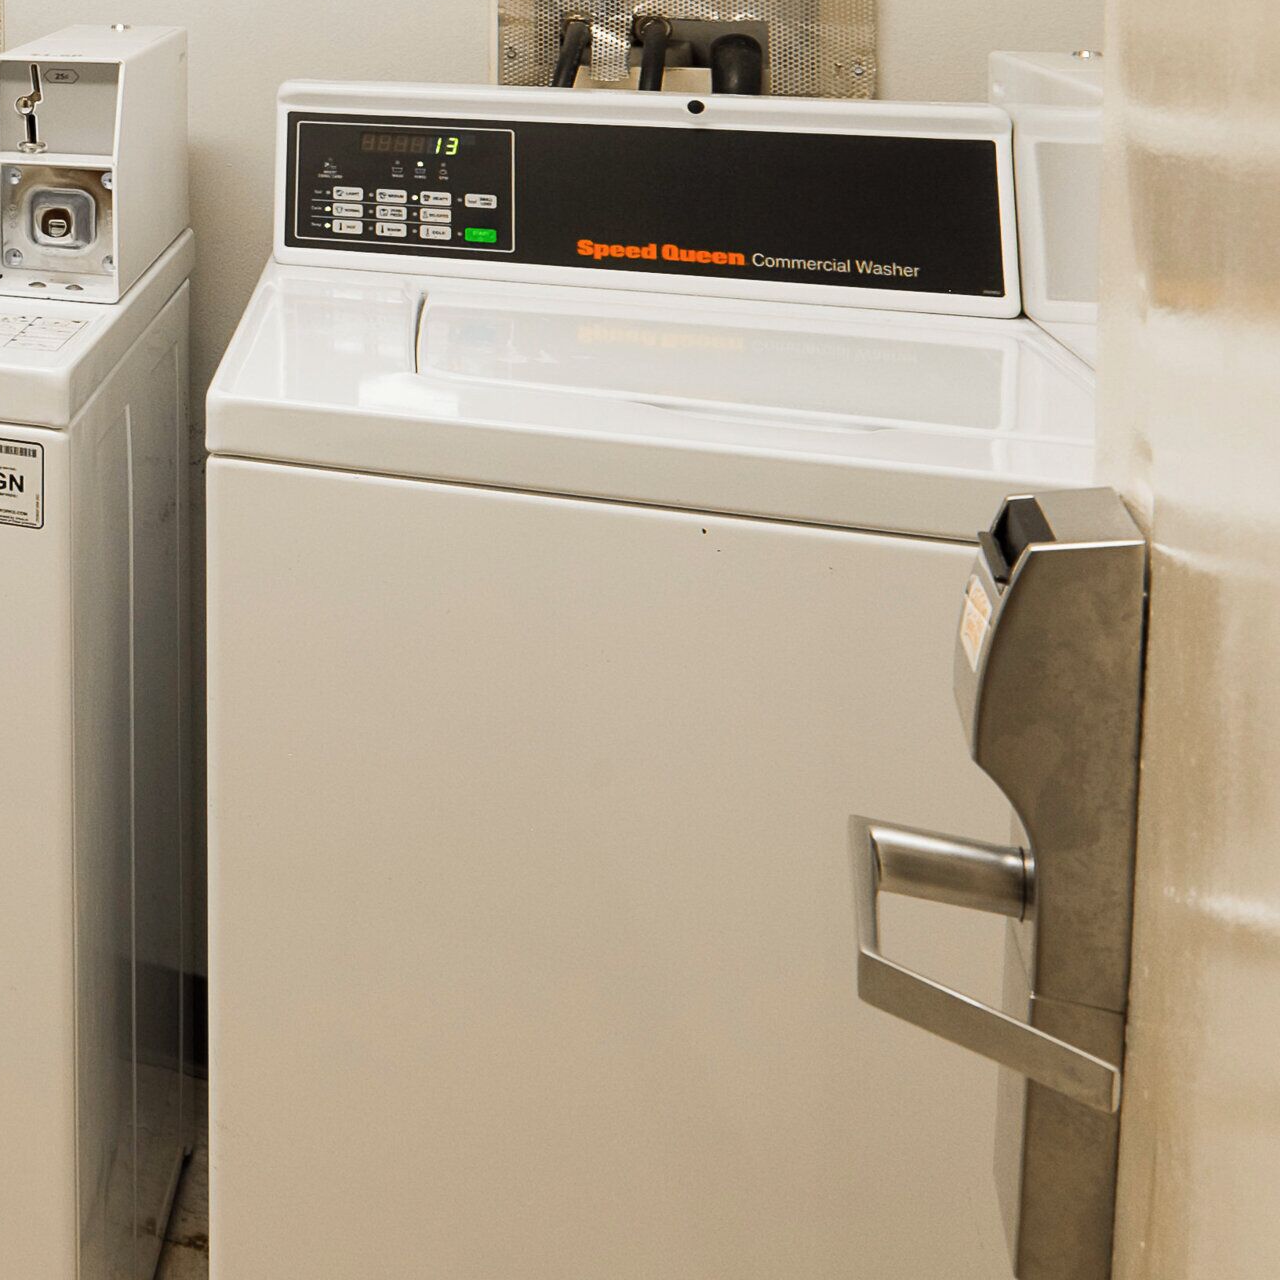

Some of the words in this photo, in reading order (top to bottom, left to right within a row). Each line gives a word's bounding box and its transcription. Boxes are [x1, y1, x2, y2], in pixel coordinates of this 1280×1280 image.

[436, 137, 459, 156] 13
[577, 239, 657, 261] Speed
[661, 244, 745, 266] Queen
[752, 253, 851, 274] Commercial
[856, 259, 920, 278] Washer
